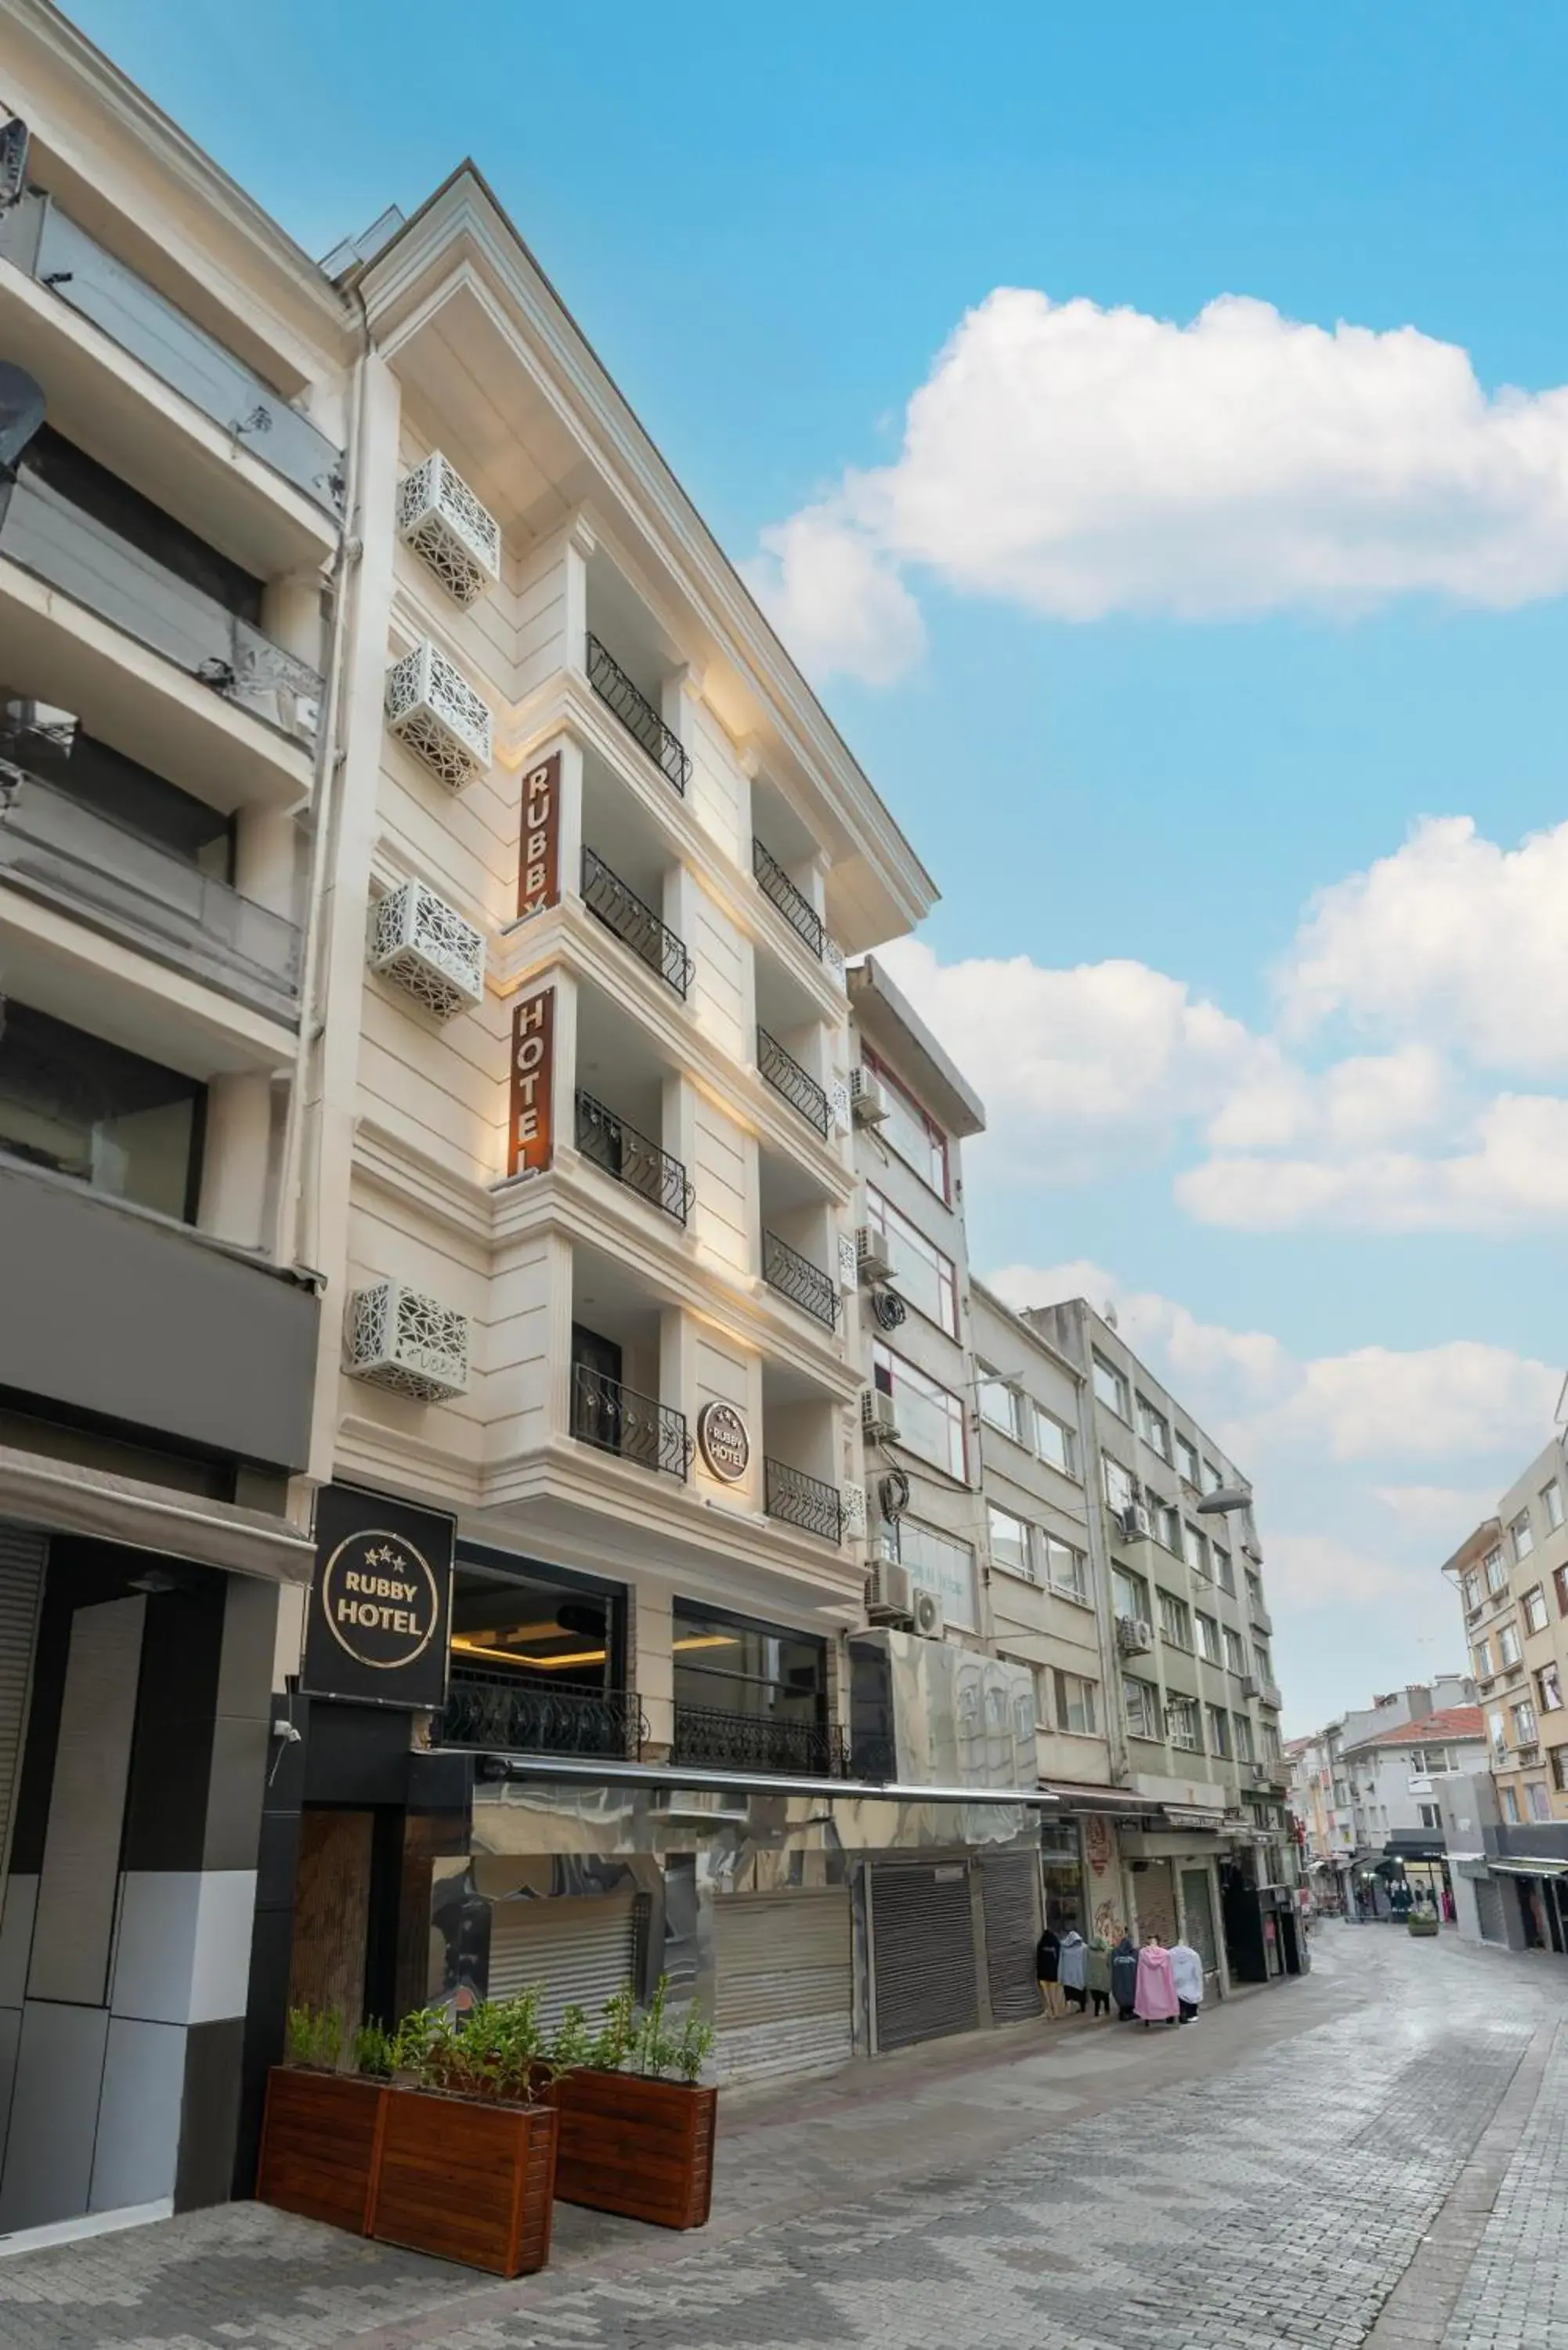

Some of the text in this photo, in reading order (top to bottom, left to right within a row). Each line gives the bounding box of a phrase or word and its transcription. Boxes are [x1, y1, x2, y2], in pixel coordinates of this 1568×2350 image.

[525, 767, 551, 914] RUBBY
[517, 999, 544, 1174] HOTEL
[714, 1426, 742, 1447] RUBBY
[710, 1443, 745, 1468] HOTEL
[346, 1571, 418, 1603] RUBBY
[337, 1599, 422, 1636] HOTEL
